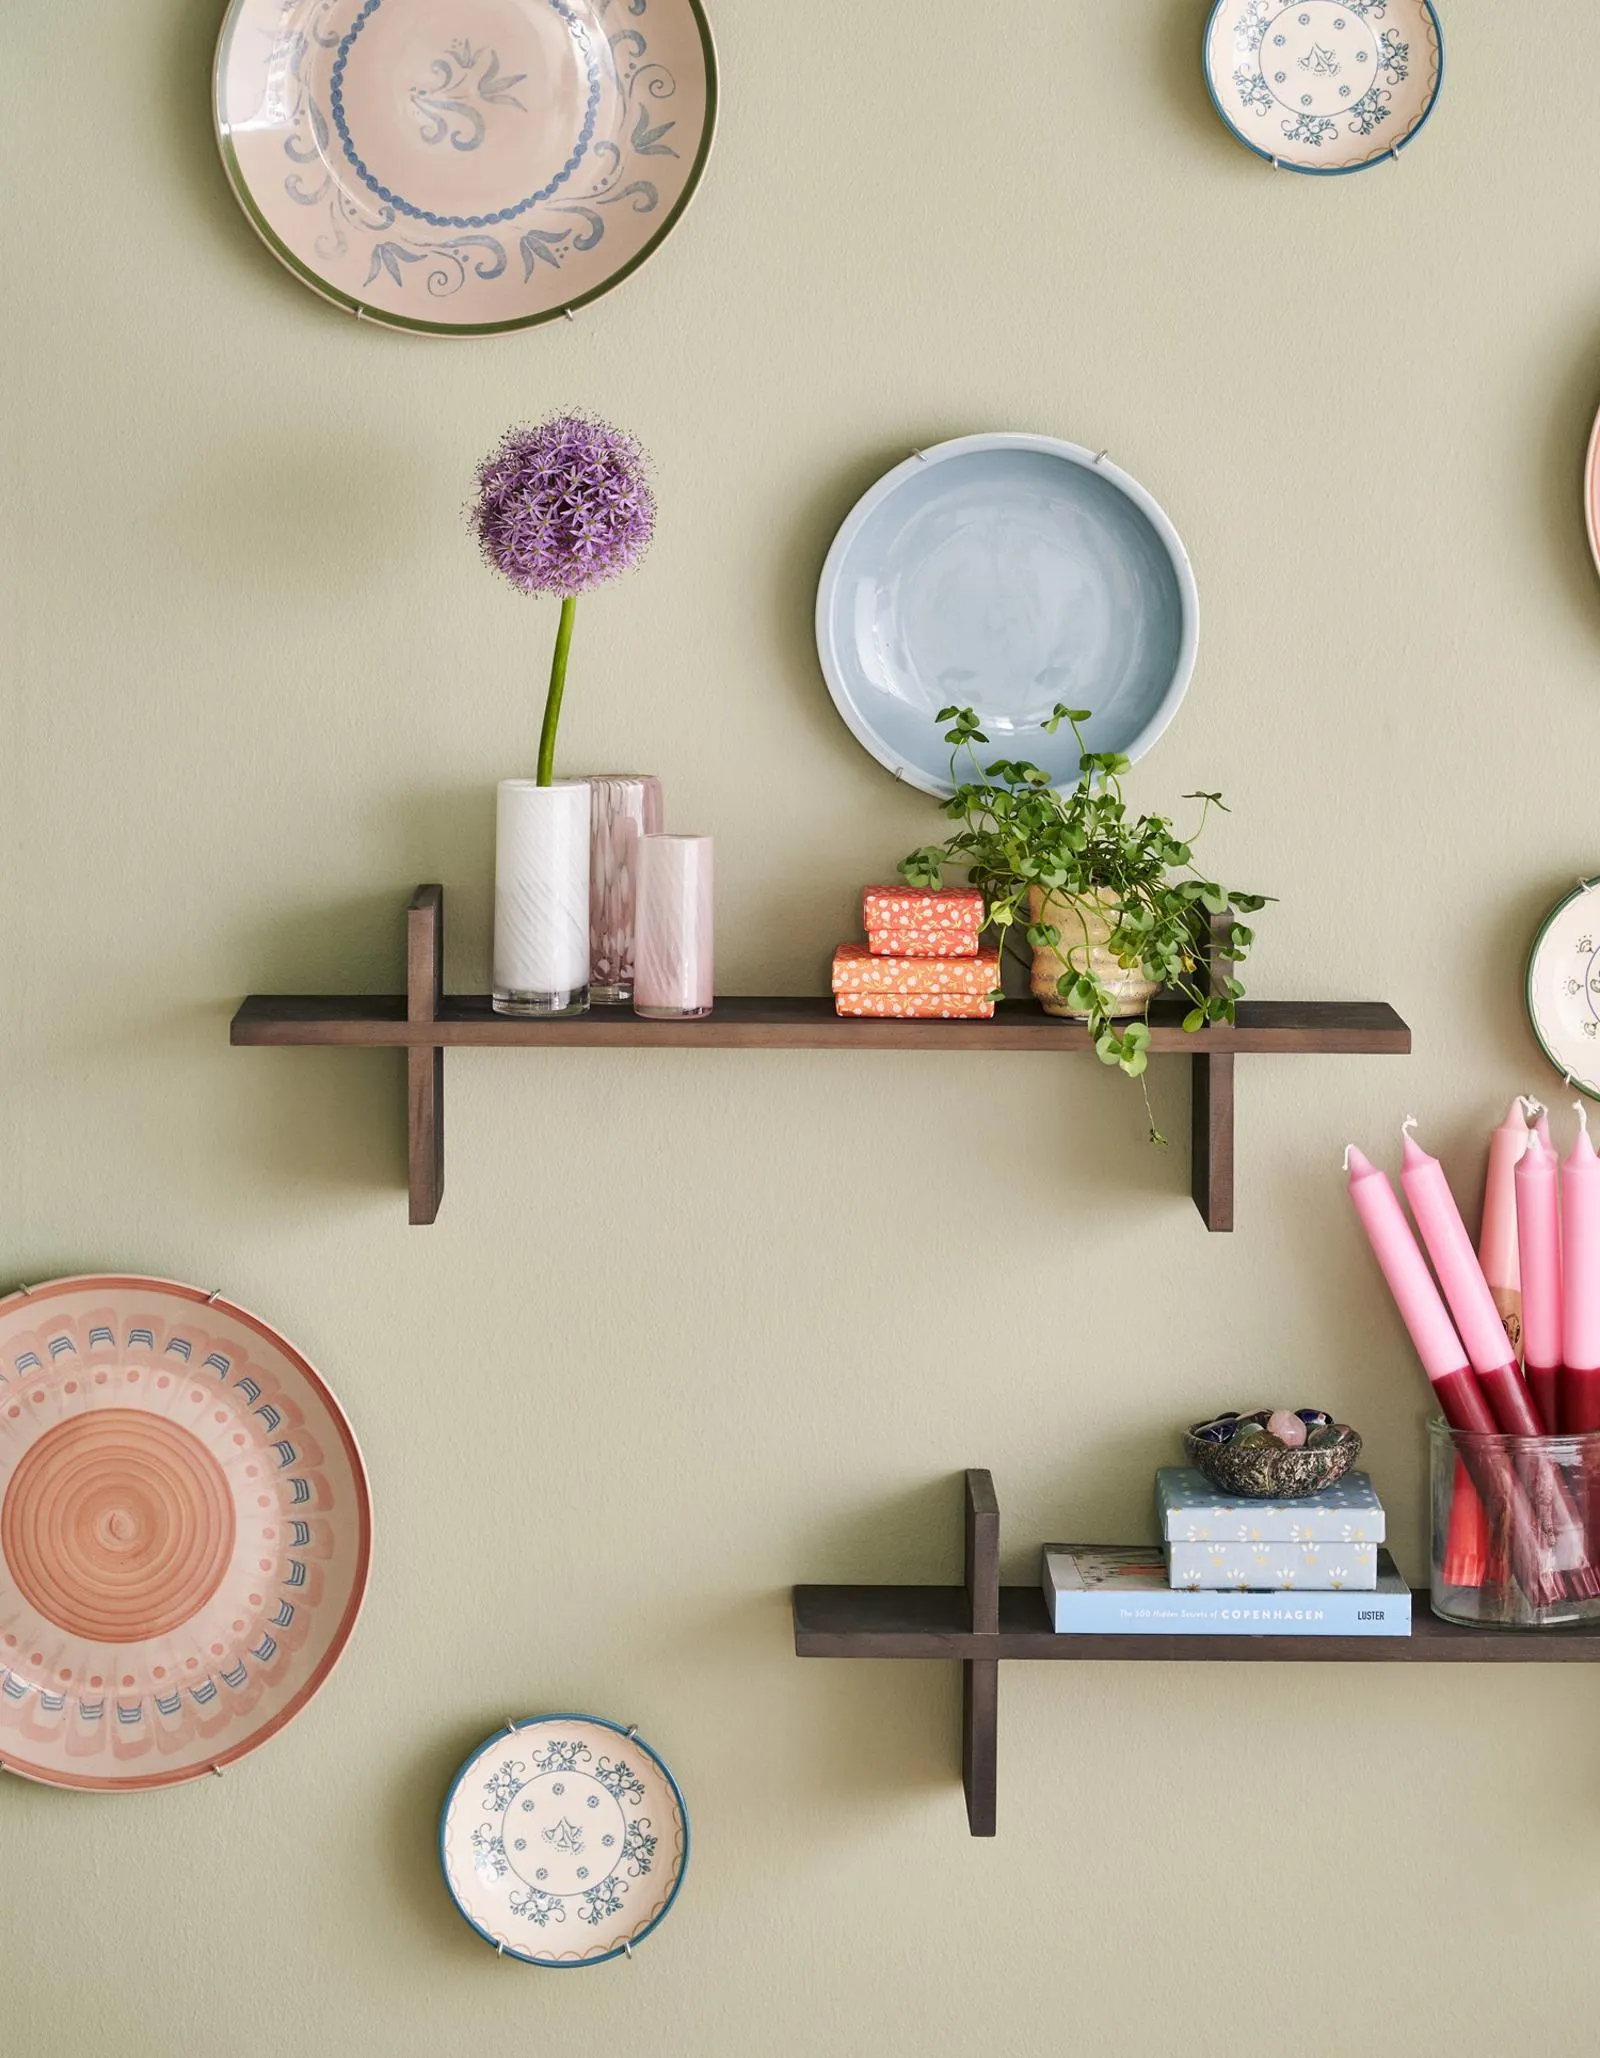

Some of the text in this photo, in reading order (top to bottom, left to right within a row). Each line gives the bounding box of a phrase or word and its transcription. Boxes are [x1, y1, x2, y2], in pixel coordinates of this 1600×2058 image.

[1120, 1609, 1325, 1620] The 500 Hidden Secrets of COPENHAGEN
[1357, 1610, 1385, 1621] LUSTER
